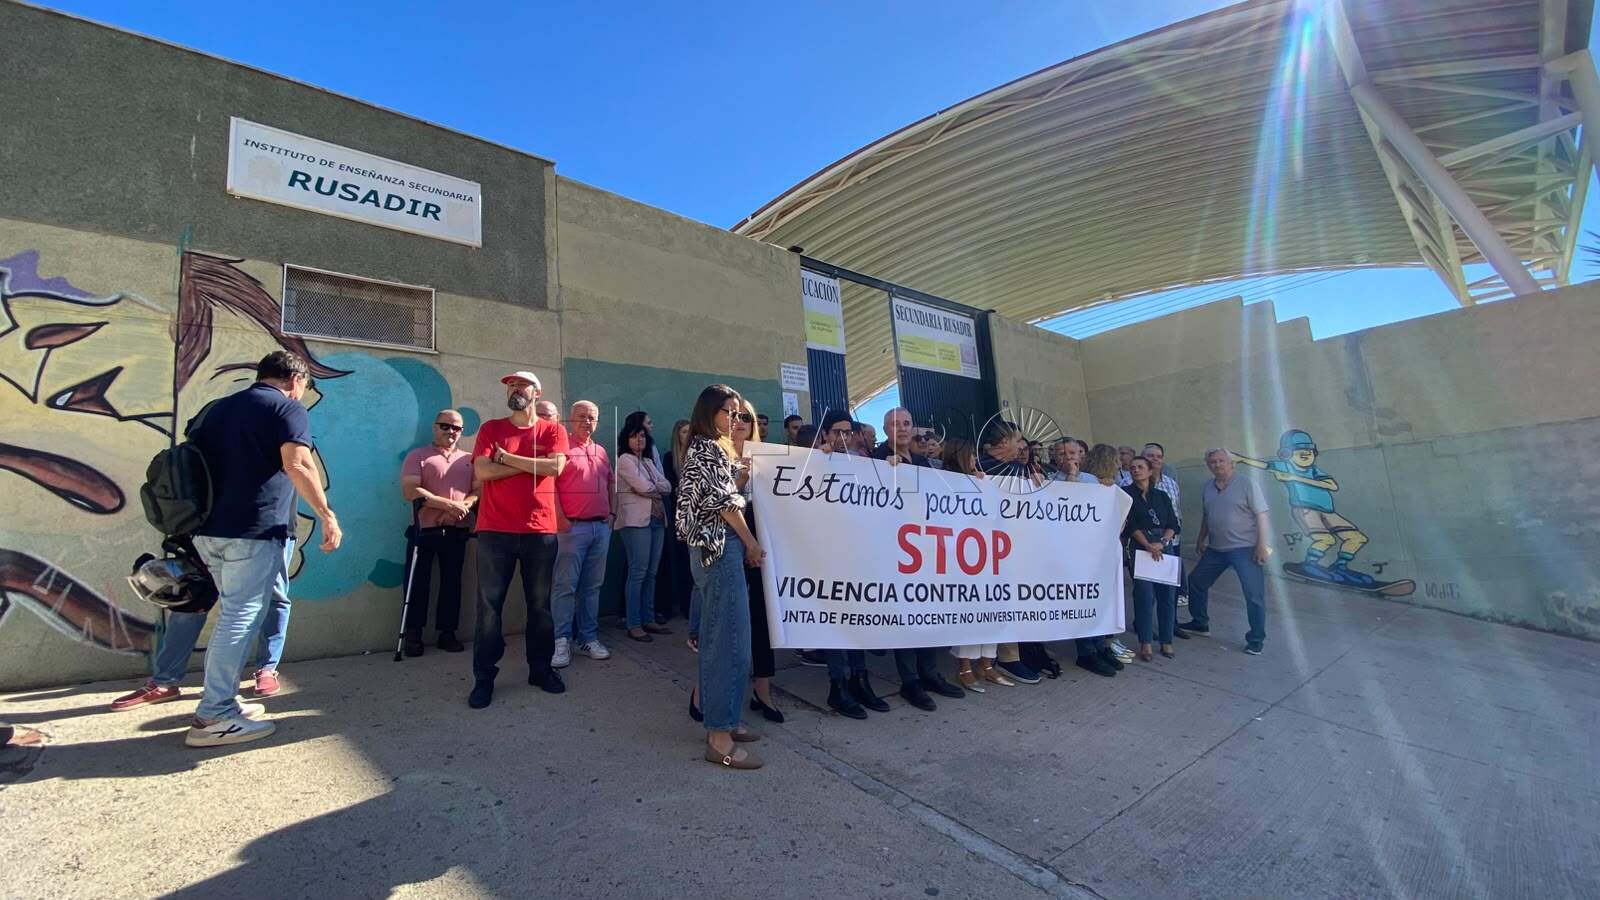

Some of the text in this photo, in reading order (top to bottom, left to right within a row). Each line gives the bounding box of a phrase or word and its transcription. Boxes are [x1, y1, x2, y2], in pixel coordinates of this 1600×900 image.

[243, 138, 474, 202] INSTITUTO DE ENSEÑANZA SECUNDARIA
[288, 169, 442, 222] RUSADIR
[895, 304, 973, 337] SECUNDARIA RUSADIR
[772, 465, 1102, 522] Estamos para enseñar
[897, 523, 1012, 576] STOP
[776, 575, 1100, 603] VIOLENCIA CONTRA LOS DOCENTES
[819, 611, 837, 625] DE
[840, 612, 905, 626] PERSONAL
[907, 613, 957, 626] DOCENTE
[960, 612, 974, 624] NO
[976, 609, 1047, 623] UNIVERSITARIO
[1049, 610, 1060, 621] DE
